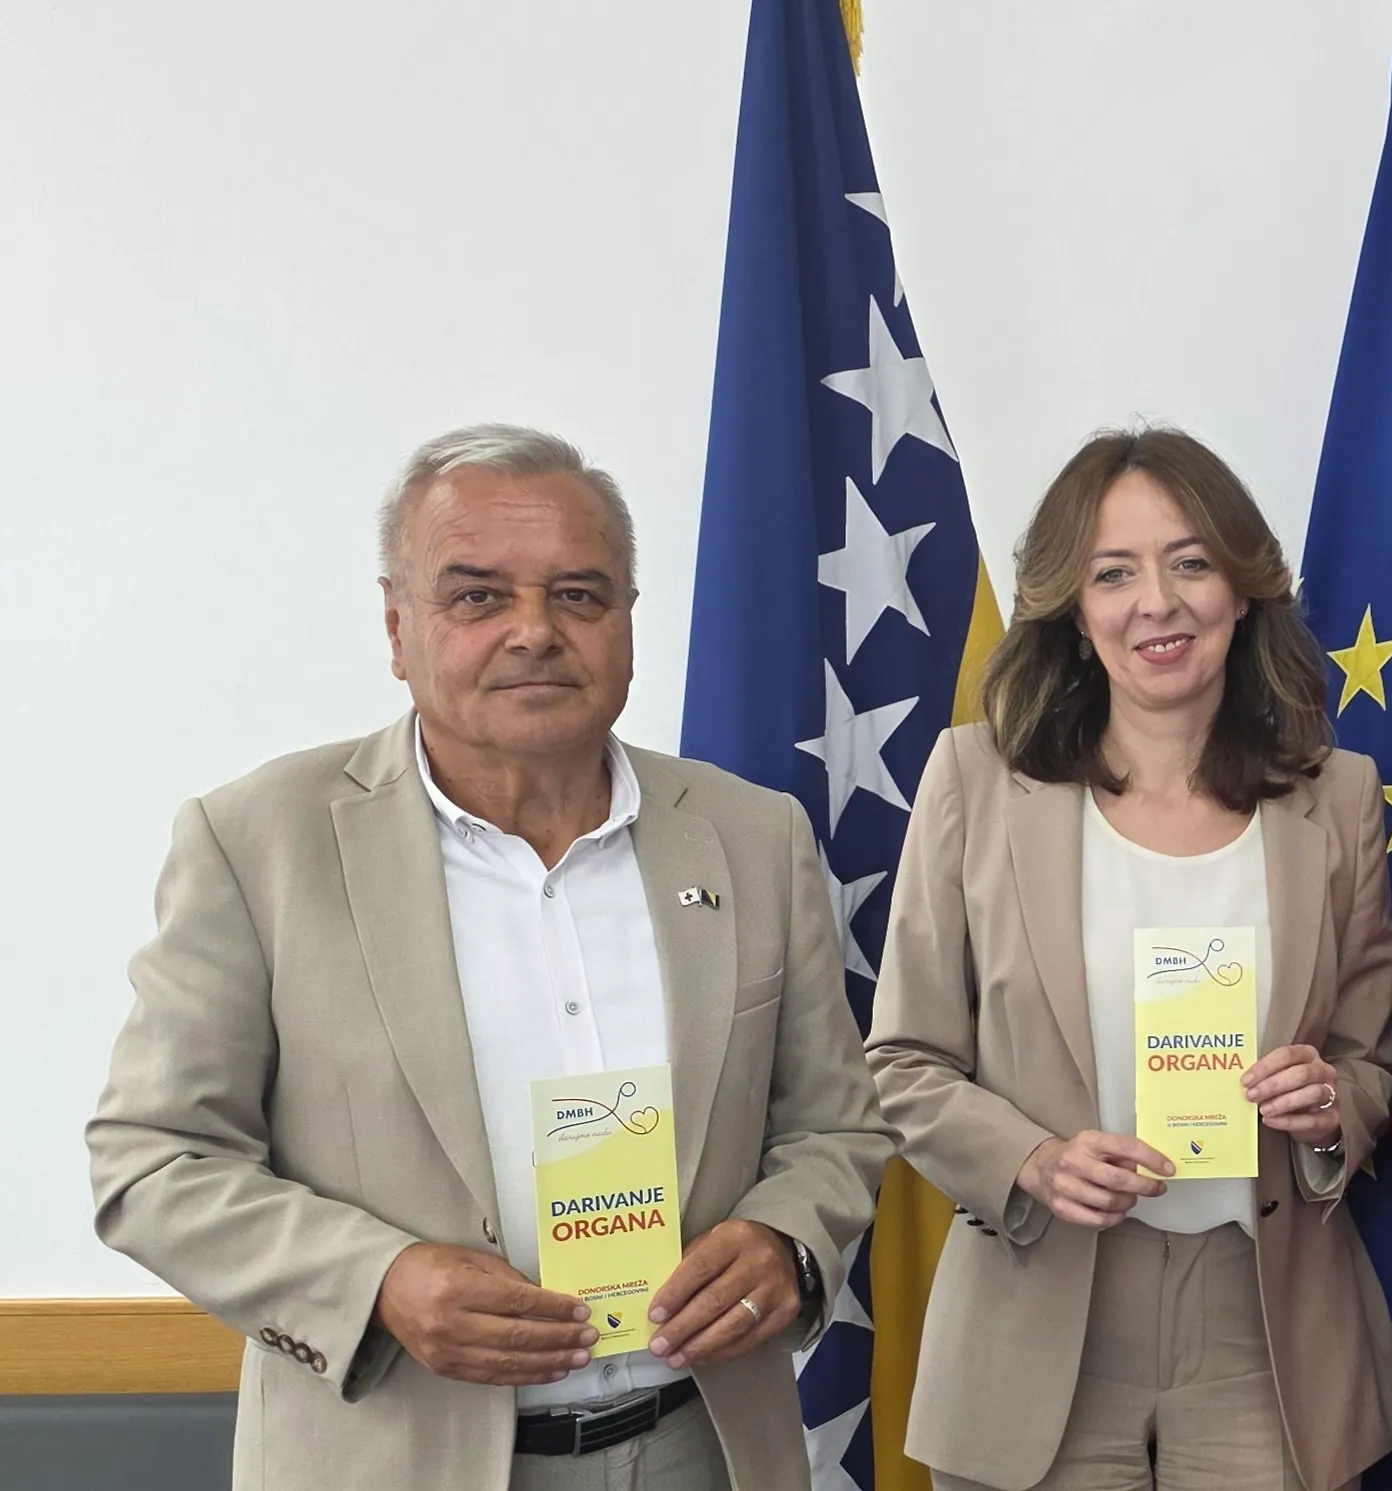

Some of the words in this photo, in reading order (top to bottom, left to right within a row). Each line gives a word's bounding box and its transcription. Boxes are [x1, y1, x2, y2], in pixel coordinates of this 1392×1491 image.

[1155, 956, 1187, 965] DMBH
[1147, 1033, 1244, 1049] DARIVANJE
[1147, 1053, 1244, 1071] ORGANA
[556, 1107, 594, 1120] DMBH
[551, 1187, 664, 1217] DARIVANJE
[552, 1209, 665, 1242] ORGANA
[578, 1283, 621, 1296] DONORSKA
